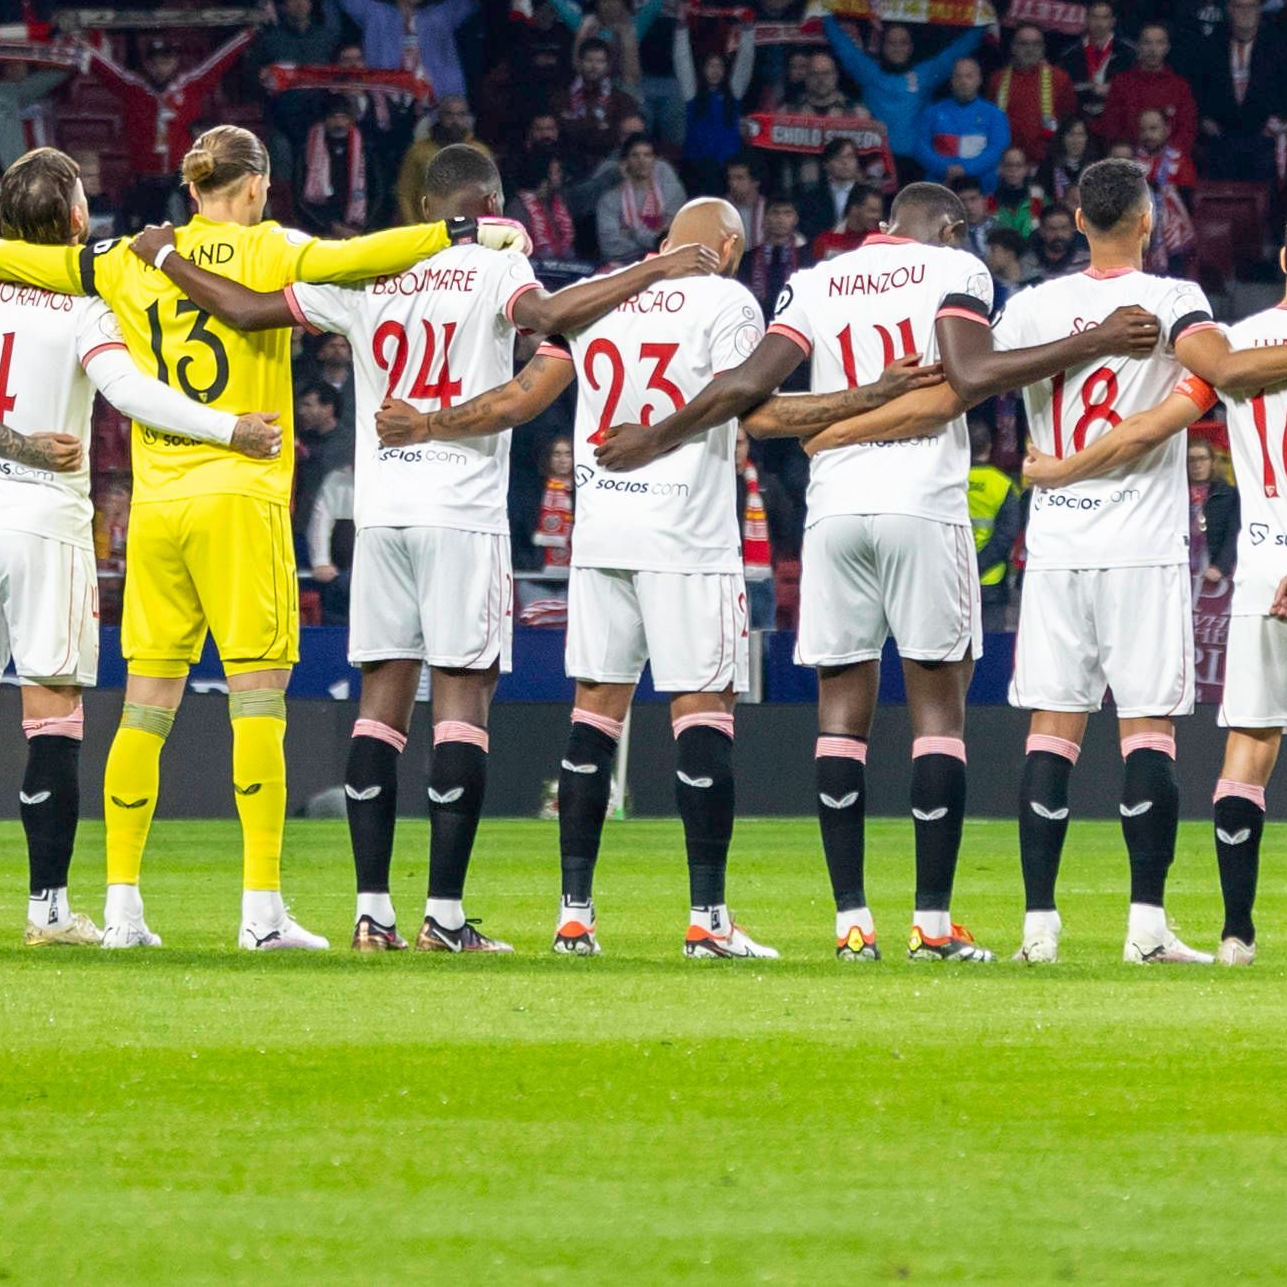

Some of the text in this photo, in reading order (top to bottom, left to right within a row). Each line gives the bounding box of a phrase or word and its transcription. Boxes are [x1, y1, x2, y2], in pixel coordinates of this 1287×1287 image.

[771, 124, 823, 147] CHOLO
[828, 264, 926, 297] NIANZOU
[144, 297, 229, 404] 13
[372, 319, 462, 410] 24
[583, 337, 686, 446] 23
[1050, 366, 1124, 461] 18
